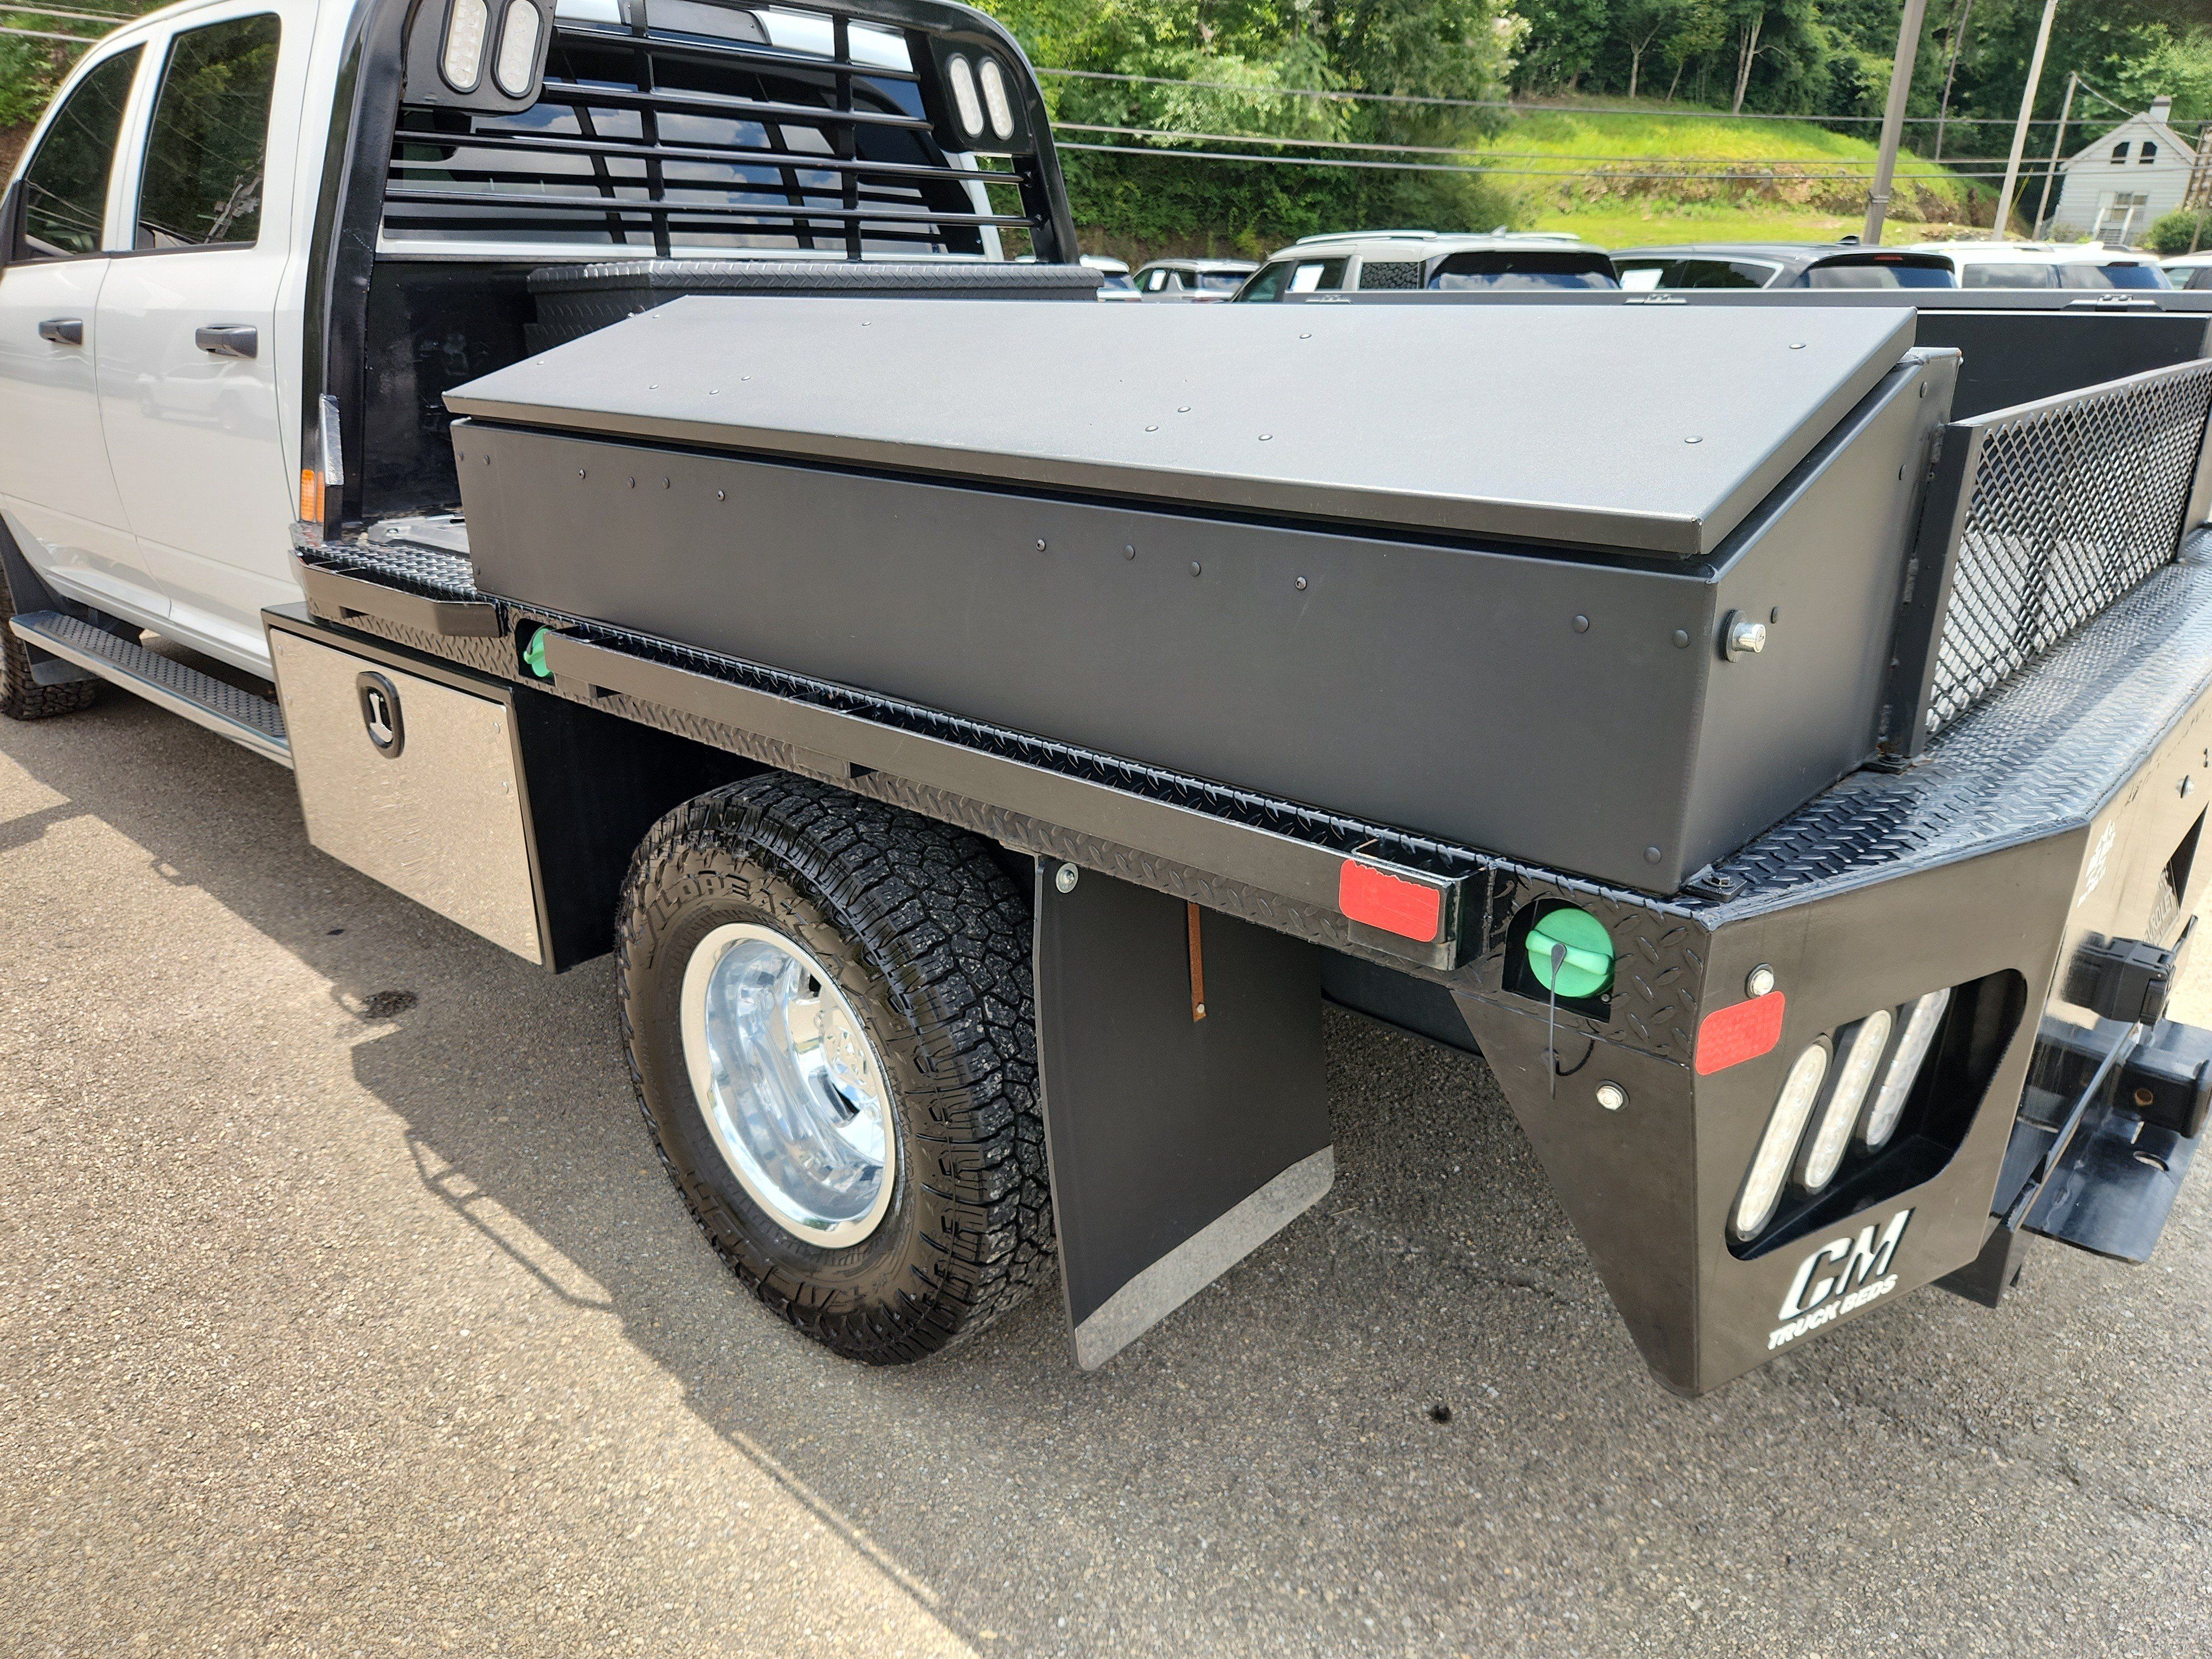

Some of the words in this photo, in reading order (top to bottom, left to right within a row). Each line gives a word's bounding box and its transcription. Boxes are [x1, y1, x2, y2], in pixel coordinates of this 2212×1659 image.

[1778, 1208, 1915, 1321] CM
[1767, 1300, 1841, 1350] TRUCK
[1839, 1274, 1898, 1315] BEDS
